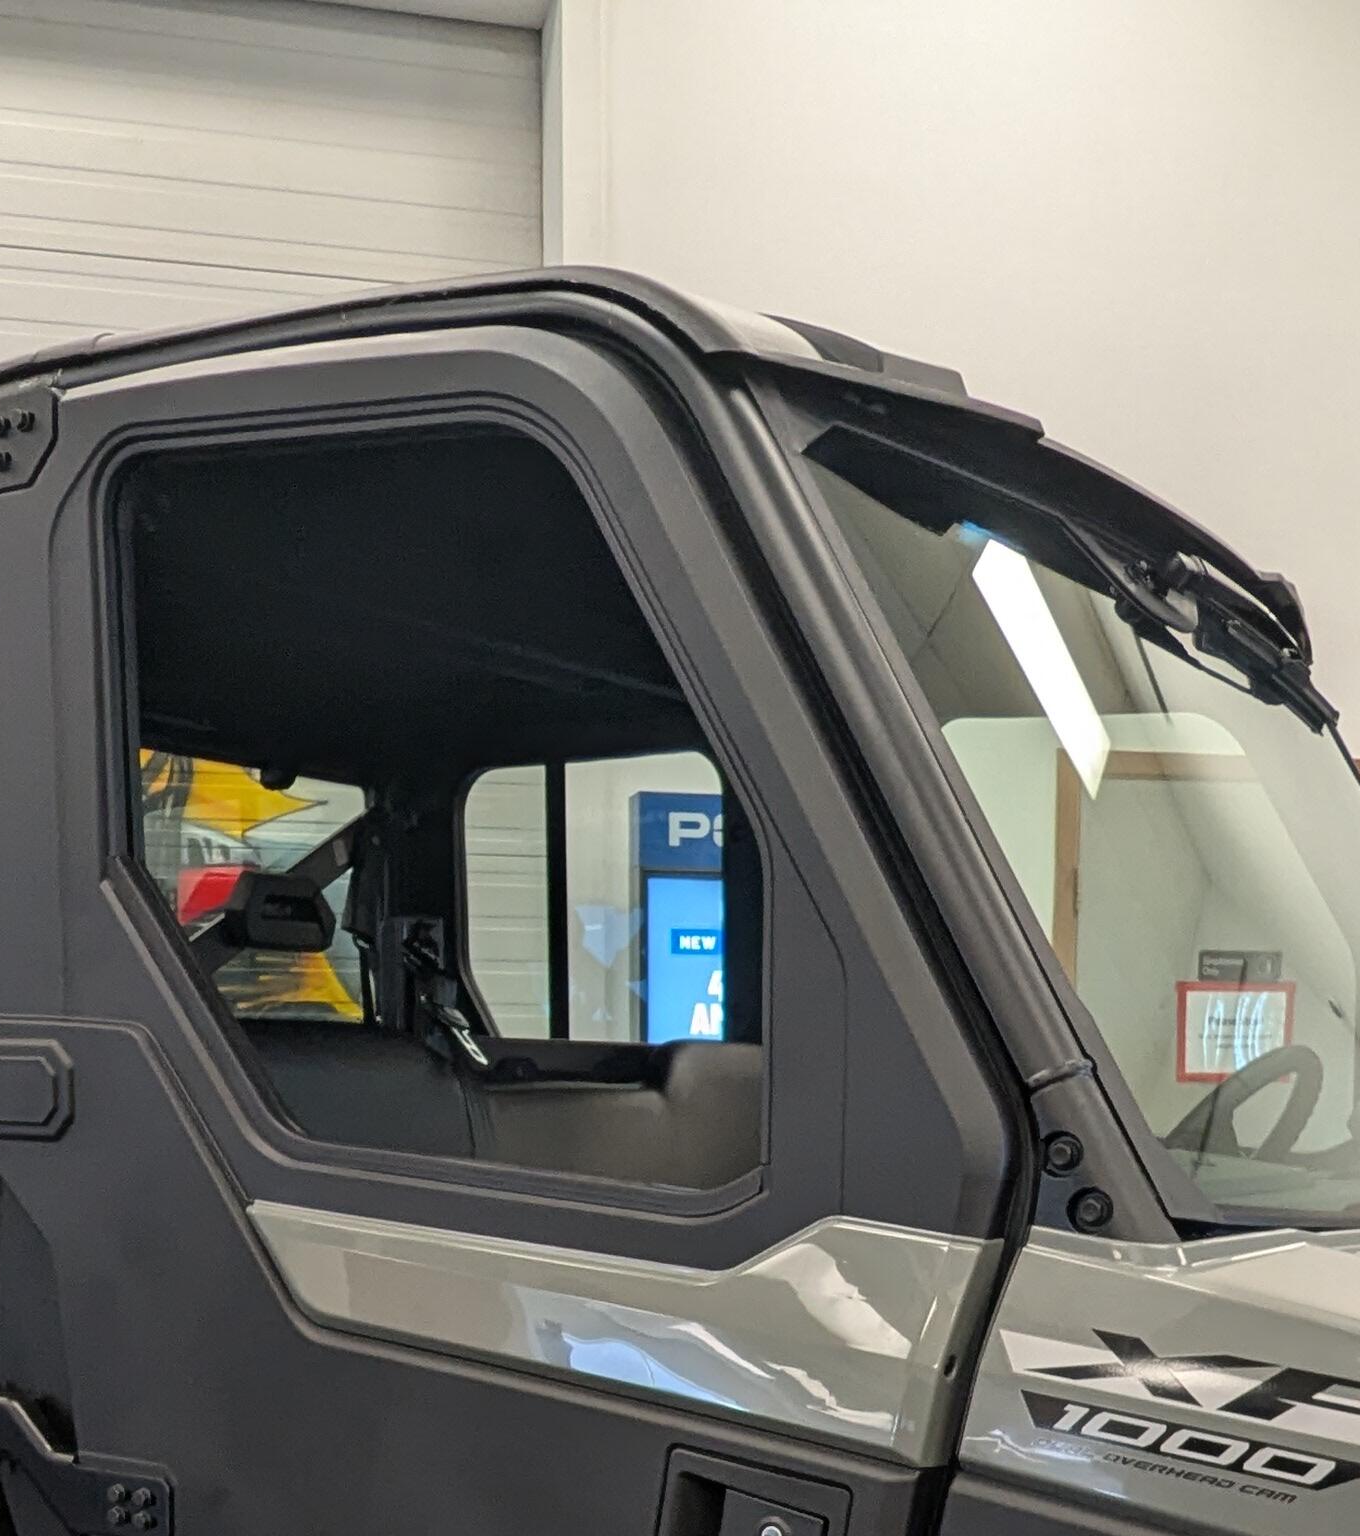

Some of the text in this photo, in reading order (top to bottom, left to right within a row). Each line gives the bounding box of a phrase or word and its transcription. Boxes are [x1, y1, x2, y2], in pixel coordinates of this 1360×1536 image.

[679, 935, 717, 950] NEW
[1052, 1404, 1337, 1486] 1000
[1103, 1453, 1299, 1504] OVERHEAD CAM
